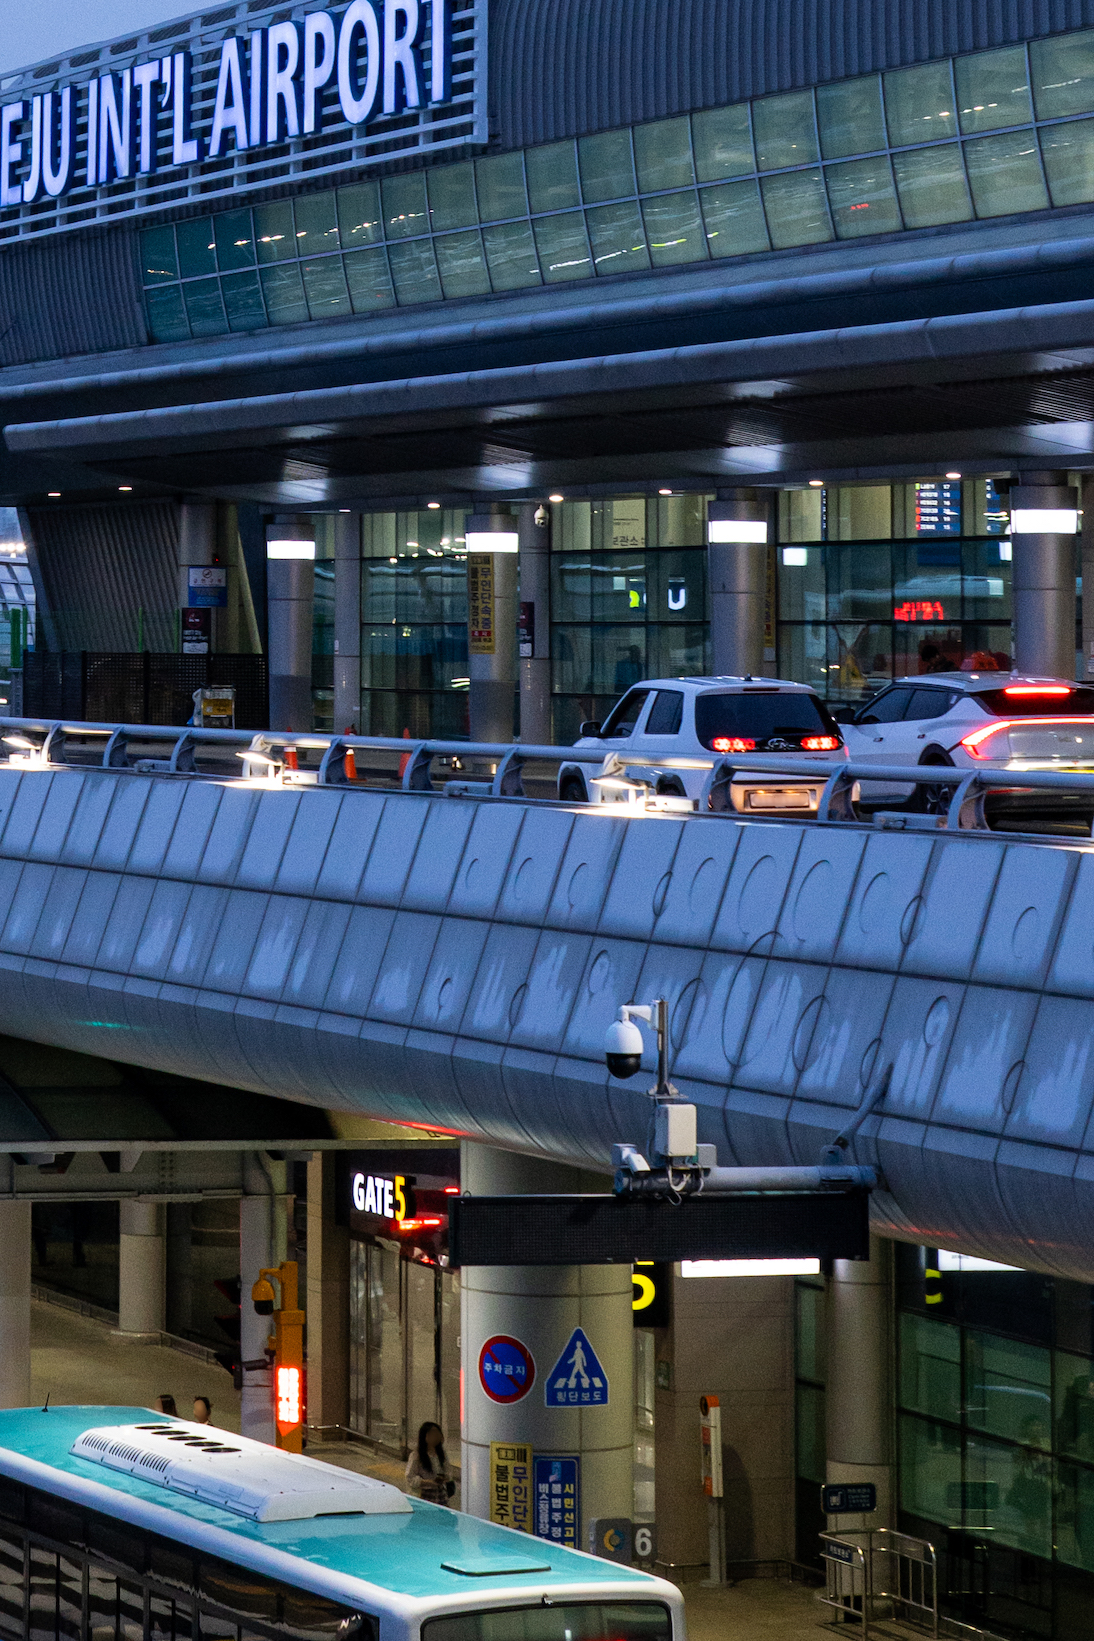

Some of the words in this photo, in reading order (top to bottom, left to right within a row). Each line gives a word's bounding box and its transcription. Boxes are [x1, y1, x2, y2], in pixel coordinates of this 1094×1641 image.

[353, 1172, 395, 1219] GATE
[394, 1174, 406, 1222] 5
[484, 1362, 526, 1376] 주차금지
[556, 1391, 602, 1402] 횡단보도
[495, 1464, 510, 1526] 불법주
[551, 1483, 563, 1542] 불법주정
[635, 1527, 653, 1557] 6
